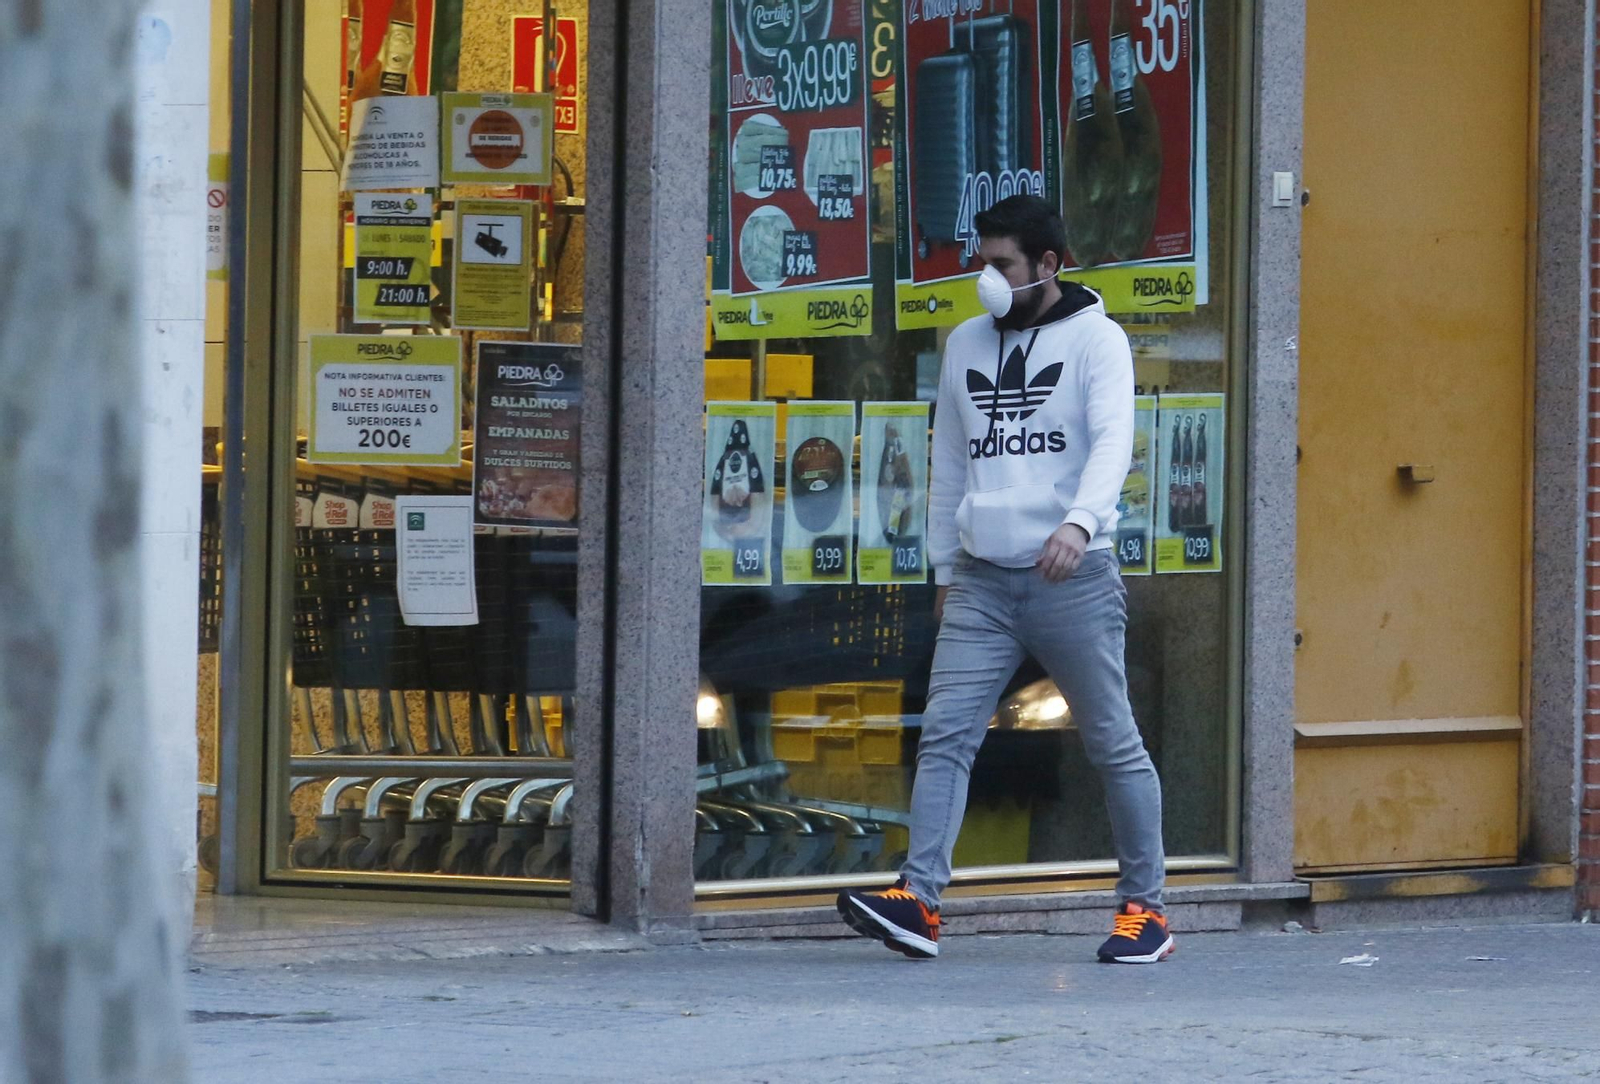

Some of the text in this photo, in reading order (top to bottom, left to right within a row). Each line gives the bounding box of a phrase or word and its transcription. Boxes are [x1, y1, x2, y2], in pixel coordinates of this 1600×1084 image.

[387, 131, 415, 140] VENTA
[390, 141, 426, 149] BEBIDAS
[761, 168, 797, 190] 10,75€
[367, 259, 408, 276] 9:00 h.
[380, 287, 428, 303] 21:00 h.
[324, 372, 446, 382] NOTA INFORMATIVA CLIENTES:
[338, 387, 431, 399] NO SE ADMITEN
[332, 402, 438, 414] BILLETES IGUALES O
[490, 395, 568, 410] SALADITOS
[347, 416, 422, 427] SUPERIORES A
[358, 429, 411, 449] 200€
[488, 426, 570, 440] EMPANADAS
[969, 427, 1067, 460] adidas
[484, 457, 572, 470] DULCES SURTIDOS
[325, 500, 346, 511] Shop
[1119, 537, 1141, 563] 4,98
[1184, 536, 1209, 560] 10,99
[736, 548, 760, 572] 4,99
[815, 547, 841, 571] 9,99
[895, 546, 917, 570] 10,75
